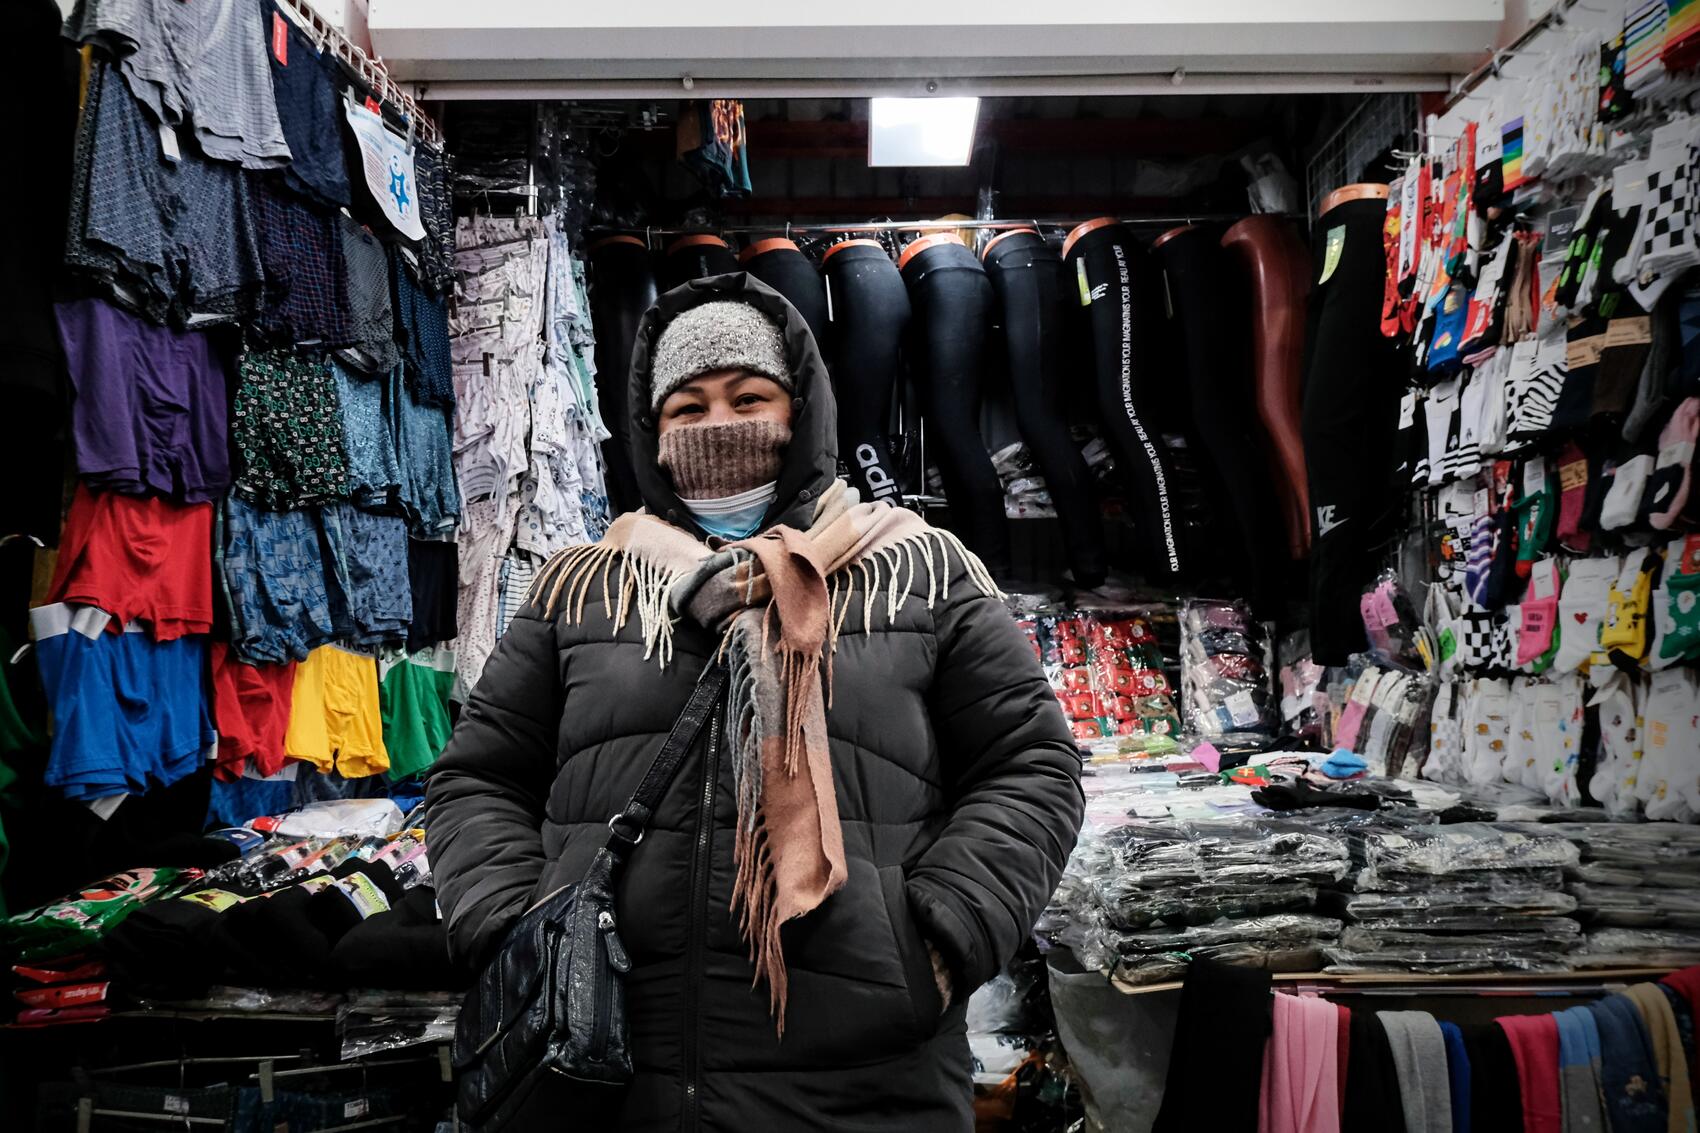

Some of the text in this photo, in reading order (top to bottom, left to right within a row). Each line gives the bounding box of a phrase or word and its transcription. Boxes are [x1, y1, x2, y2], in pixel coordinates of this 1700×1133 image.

[1121, 286, 1131, 303] YOUR
[1121, 343, 1131, 358] YOUR
[1125, 402, 1136, 418] YOUR
[1144, 442, 1156, 458] YOUR
[1159, 496, 1169, 513] YOUR
